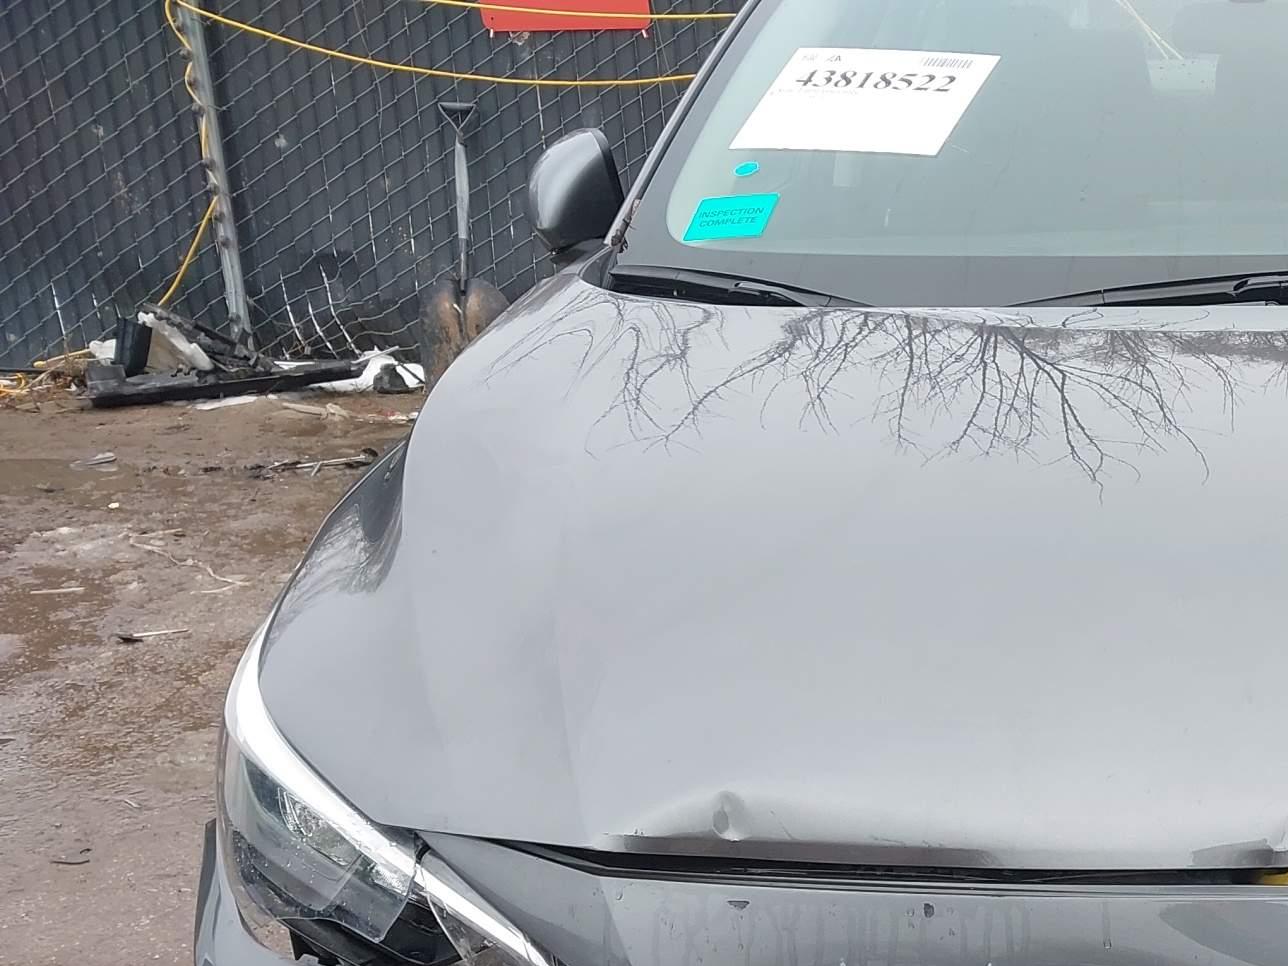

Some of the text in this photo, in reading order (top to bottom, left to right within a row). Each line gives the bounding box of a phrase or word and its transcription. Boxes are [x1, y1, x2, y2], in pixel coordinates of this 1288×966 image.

[795, 69, 957, 92] 43818522
[698, 207, 765, 218] INSPECTION
[699, 216, 757, 228] COMPLETE
